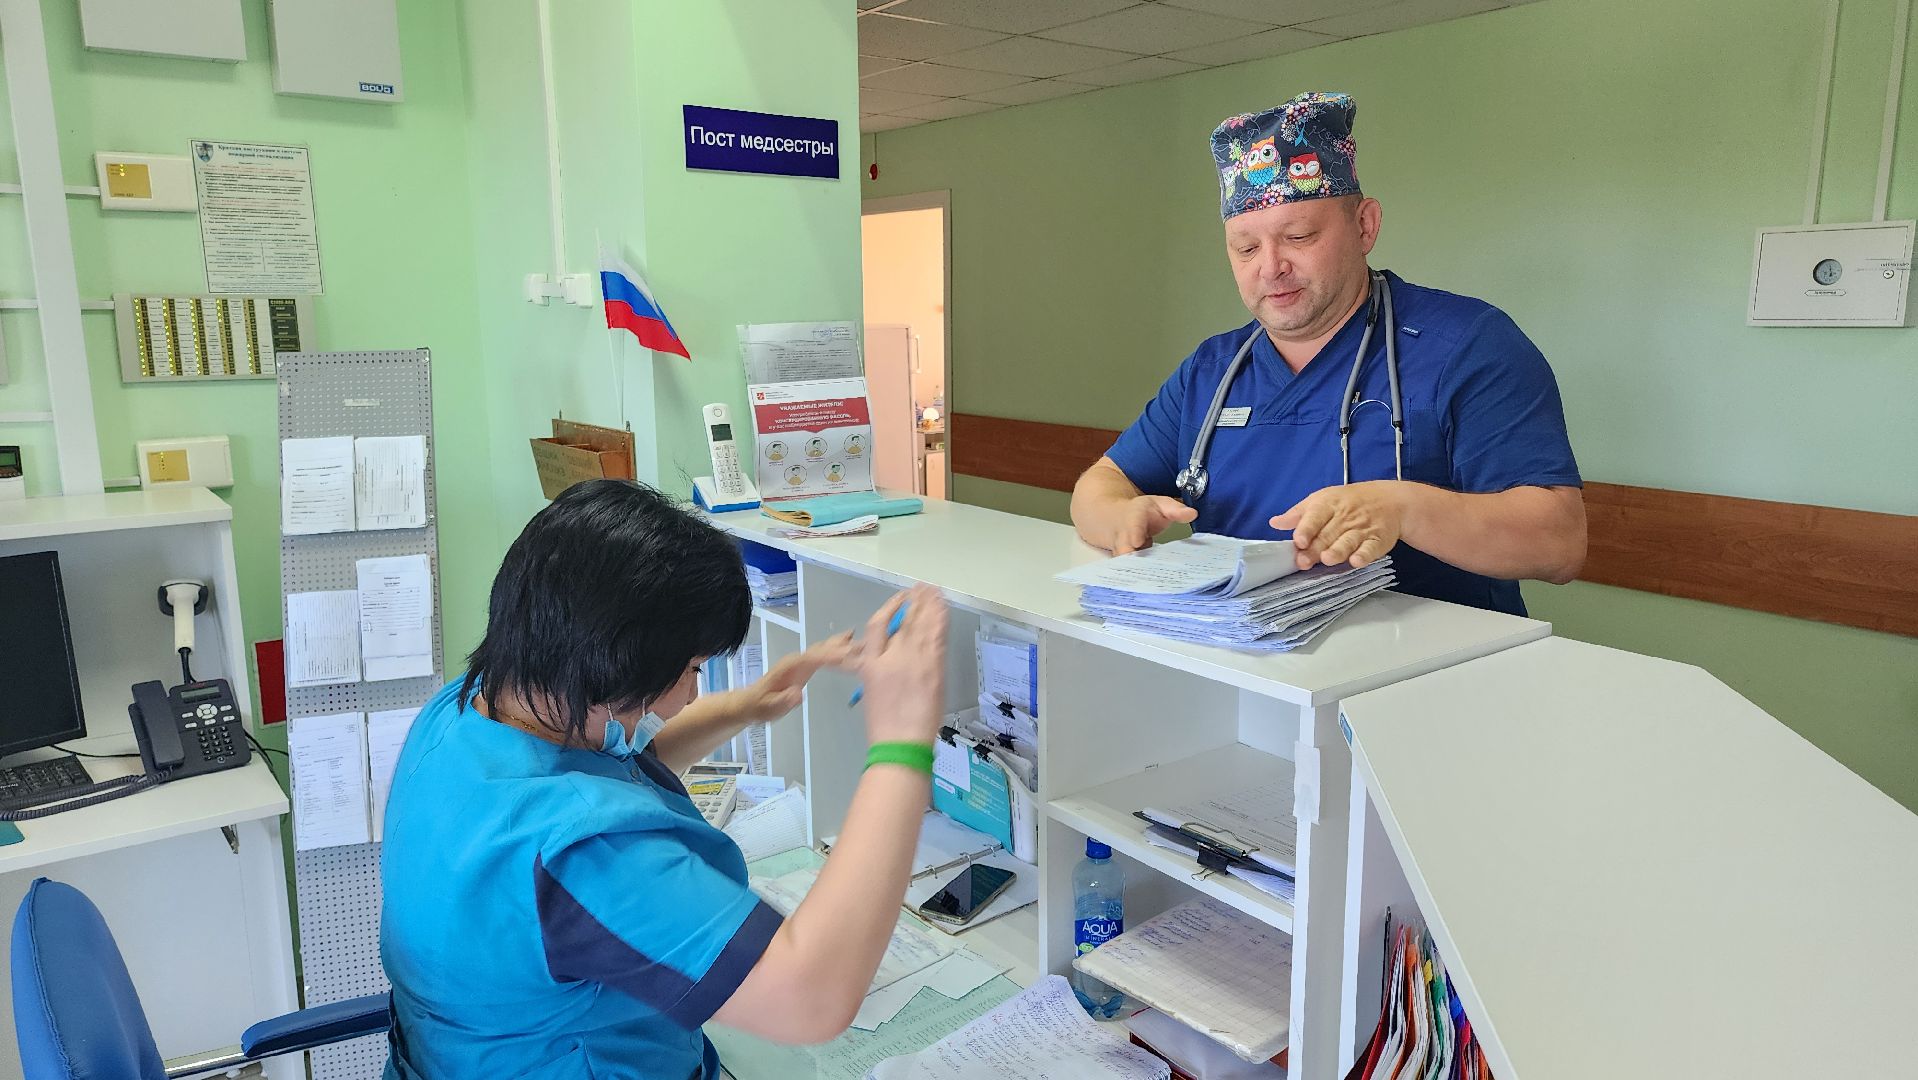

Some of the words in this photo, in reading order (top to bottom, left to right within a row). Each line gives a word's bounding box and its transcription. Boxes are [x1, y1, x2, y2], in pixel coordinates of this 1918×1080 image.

[690, 125, 735, 148] Пост
[740, 134, 834, 158] медсестры
[780, 403, 817, 411] УВАЖАЕМЫЕ
[1082, 920, 1118, 938] AQUA
